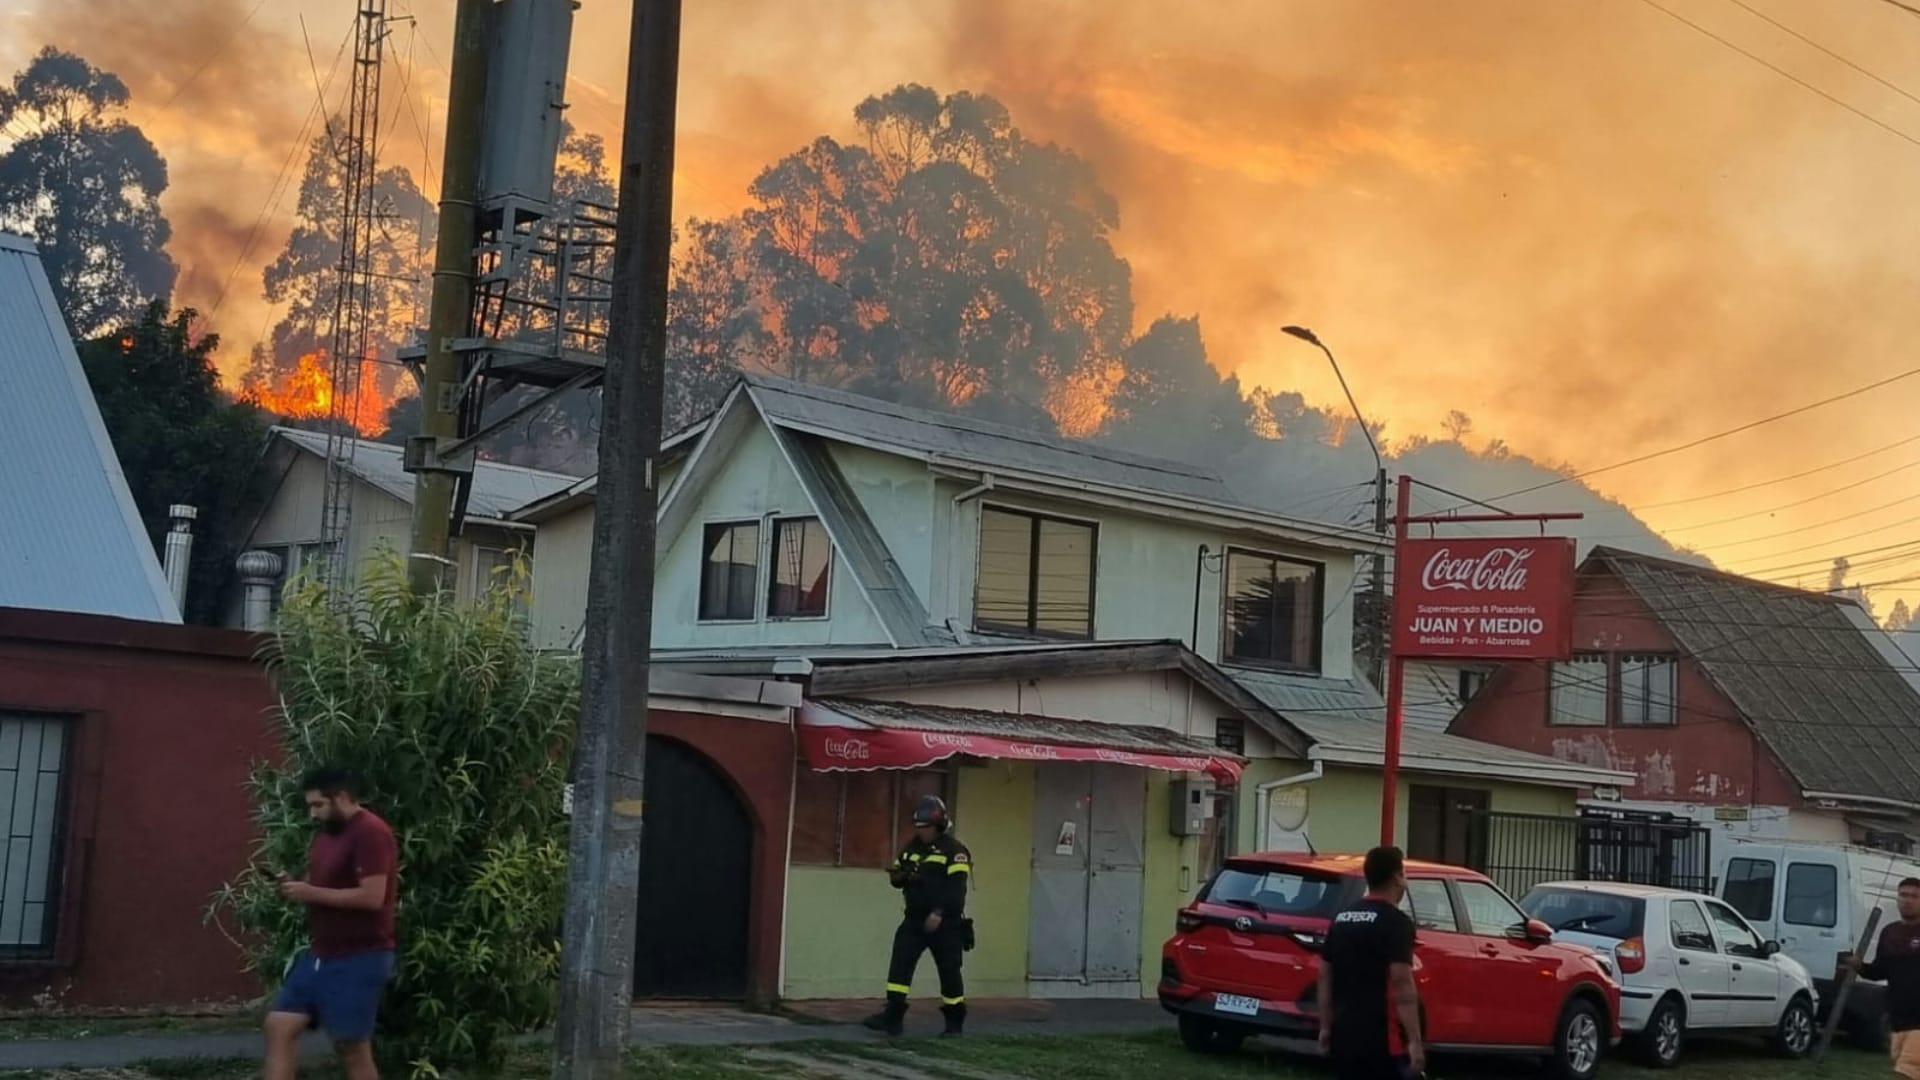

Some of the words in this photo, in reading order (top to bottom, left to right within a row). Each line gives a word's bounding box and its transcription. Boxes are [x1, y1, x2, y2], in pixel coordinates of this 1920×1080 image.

[1417, 604, 1481, 614] Supermercado
[1482, 605, 1489, 613] &
[1409, 617, 1458, 633] JUAN
[1463, 618, 1475, 633] Y
[1480, 618, 1543, 634] MEDIO
[1419, 636, 1454, 645] Bebidas
[1461, 637, 1478, 645] Pan
[1486, 637, 1531, 646] Abarrotes
